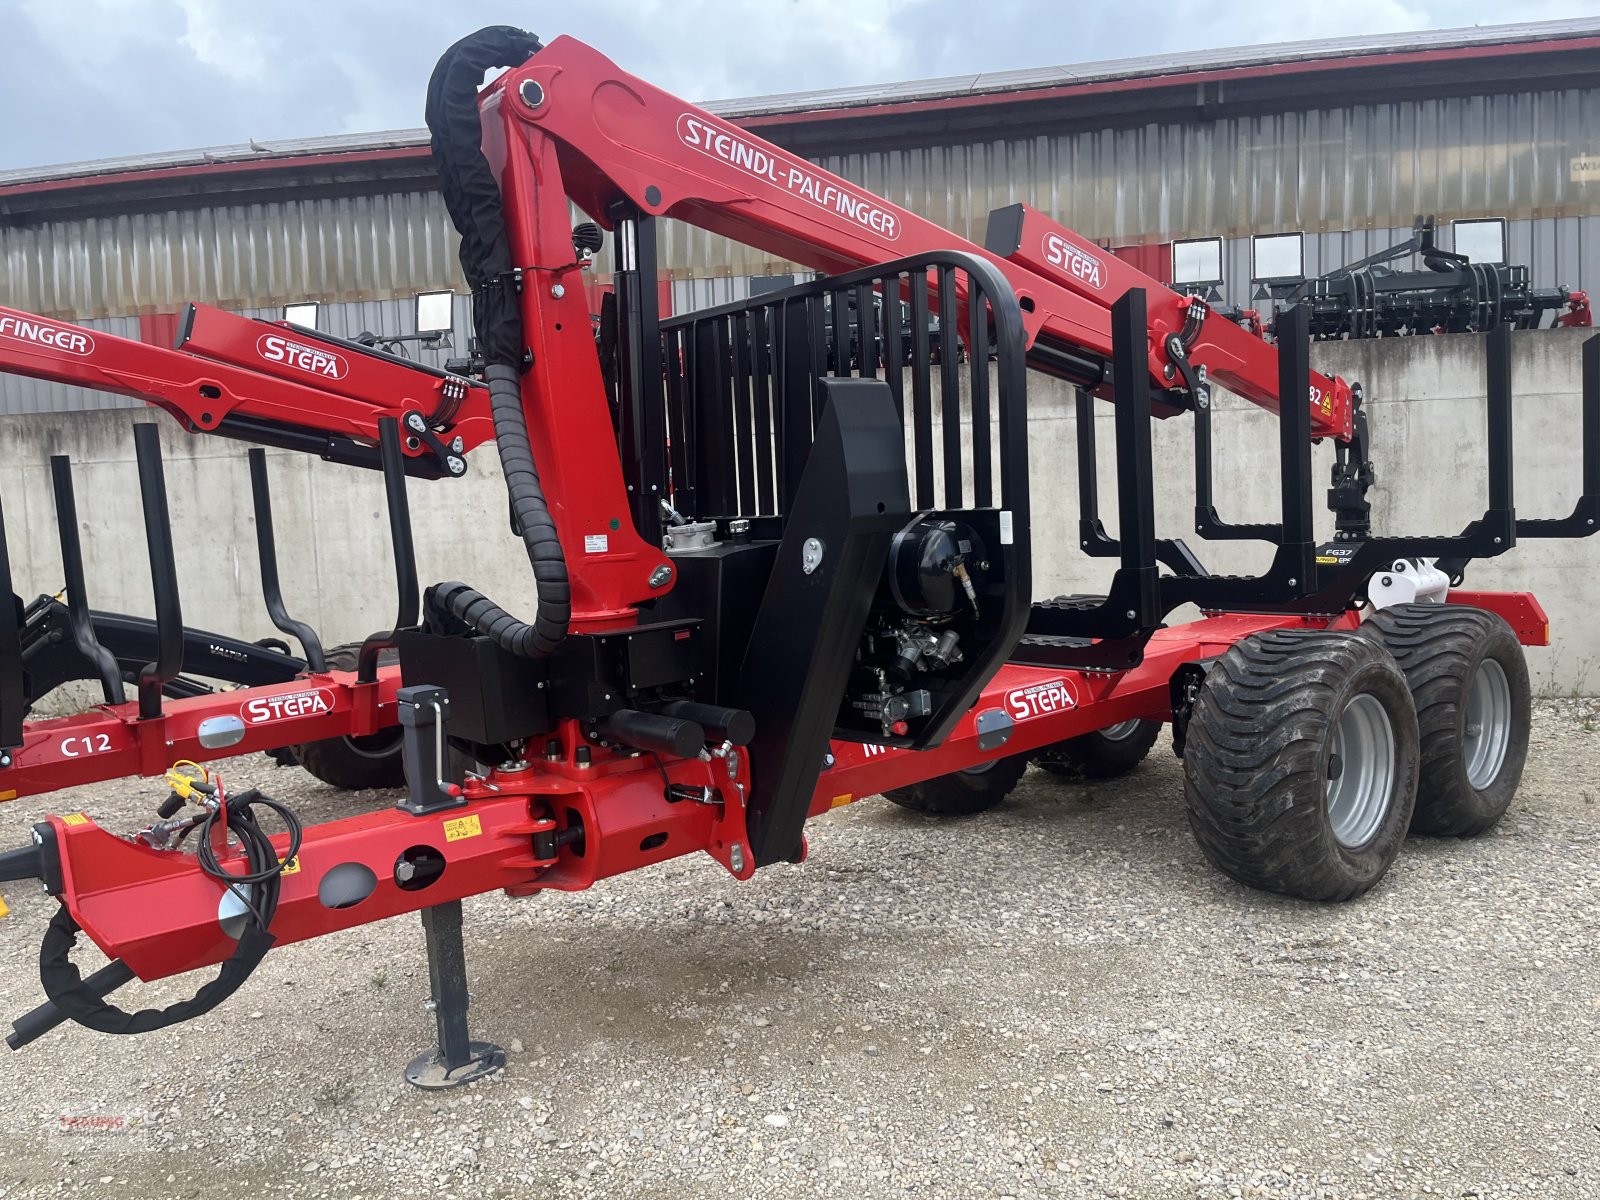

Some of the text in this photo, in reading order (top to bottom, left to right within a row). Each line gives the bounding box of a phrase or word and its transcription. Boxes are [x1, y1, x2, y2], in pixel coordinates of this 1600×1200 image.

[685, 119, 895, 237] STEINDL-PALFINGER
[1047, 235, 1100, 288] STEPA
[264, 336, 338, 378] STEPA
[248, 695, 329, 723] STEPA
[1009, 686, 1075, 720] STEPA
[60, 733, 112, 757] C12
